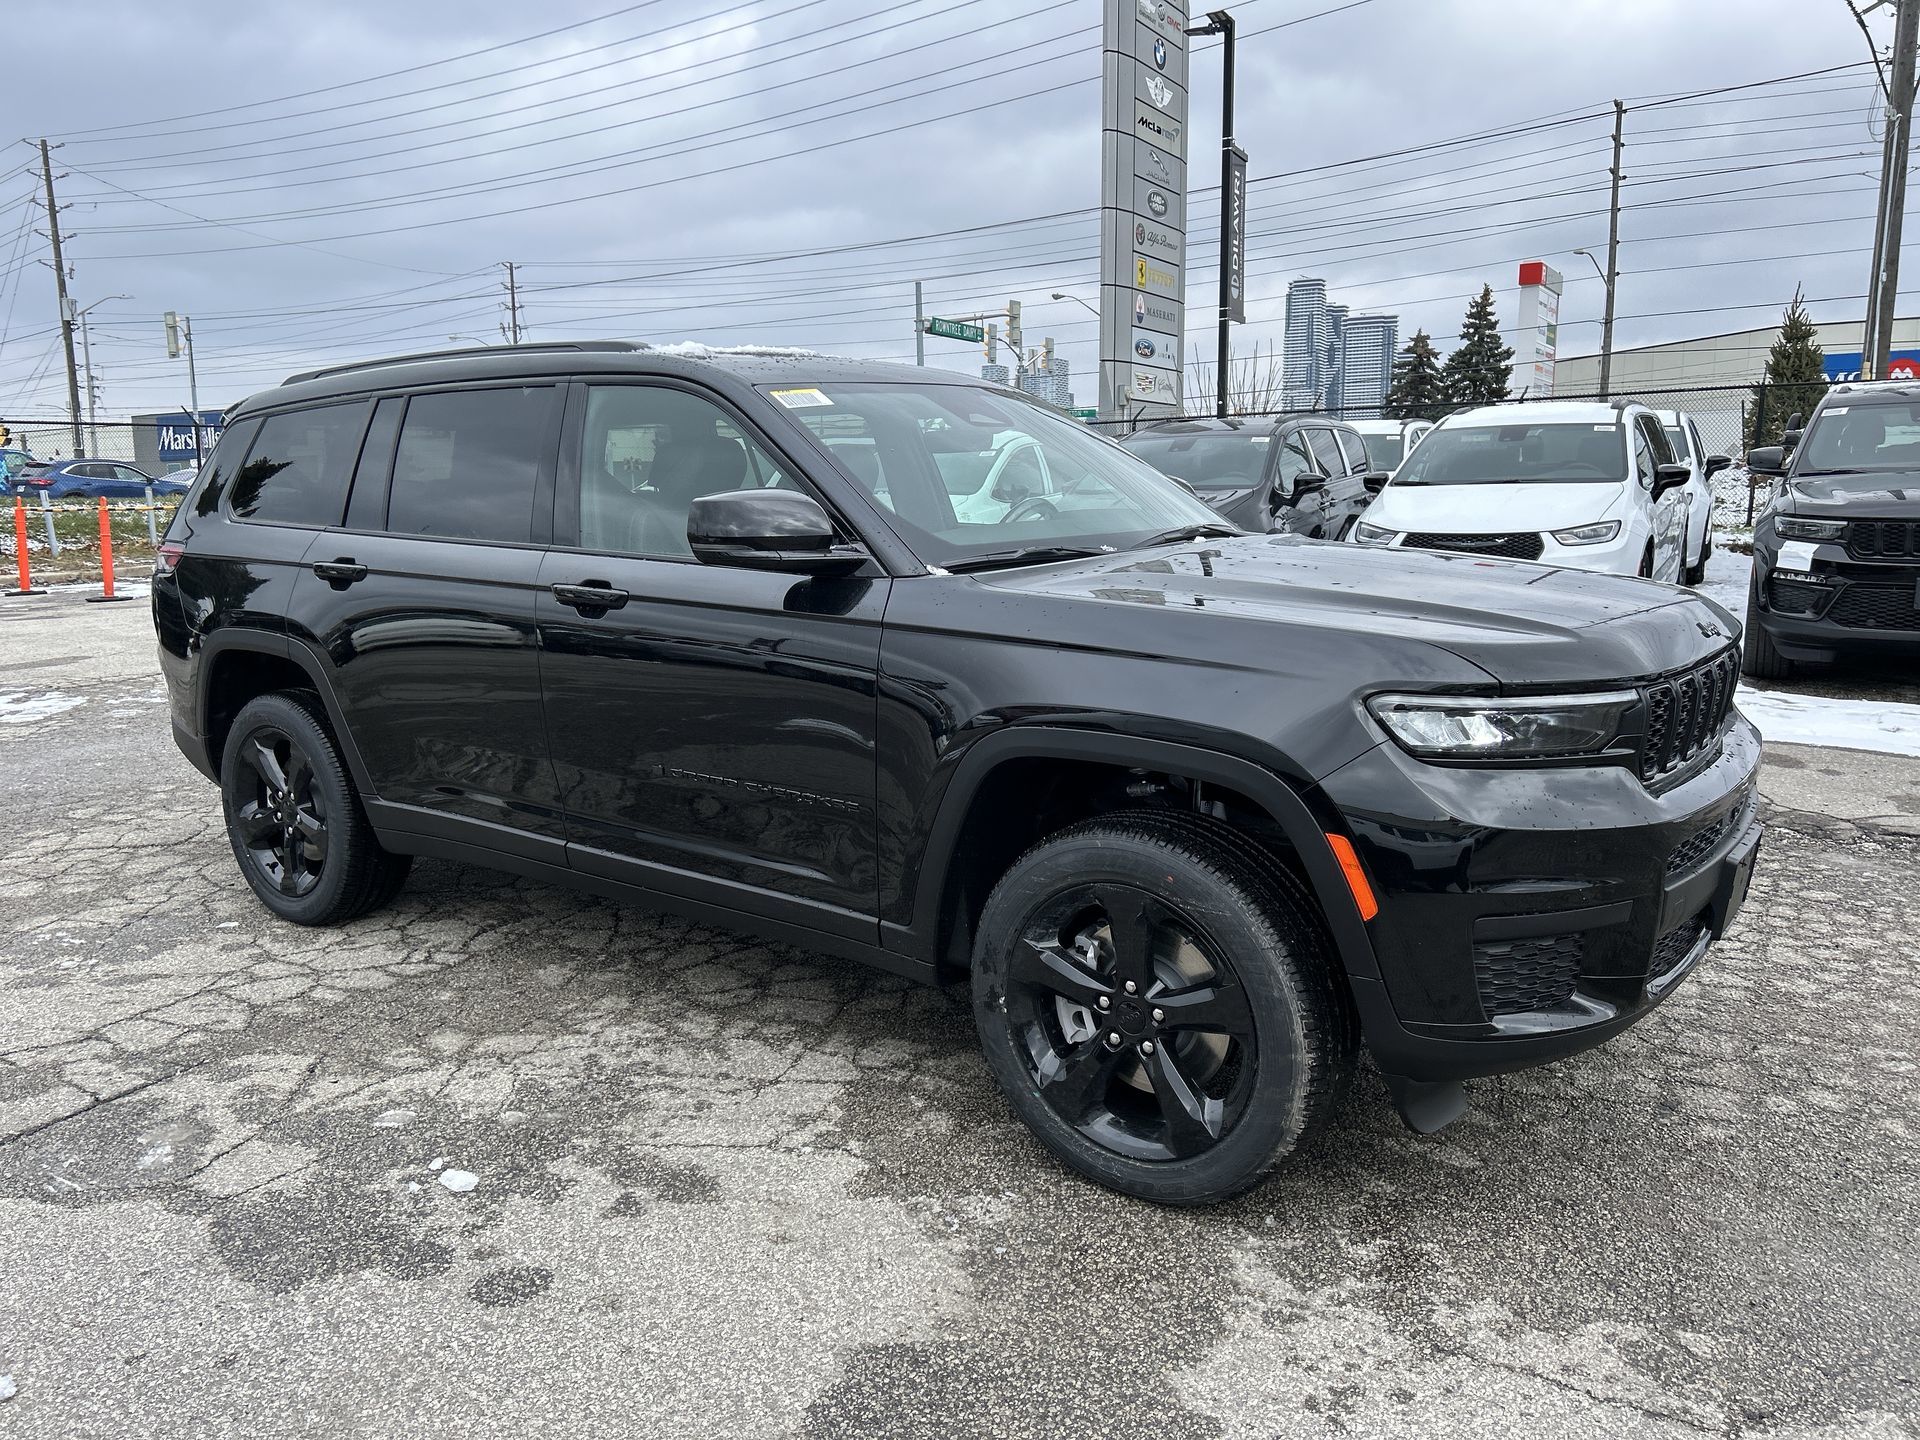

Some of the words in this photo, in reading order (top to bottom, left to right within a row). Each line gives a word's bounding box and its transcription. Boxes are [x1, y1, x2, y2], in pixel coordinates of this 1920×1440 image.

[1167, 16, 1181, 32] GMC
[1137, 116, 1175, 142] McLaren
[1145, 170, 1170, 185] JAGUAR
[1150, 193, 1163, 204] LAND
[1232, 170, 1240, 271] DILAWRI
[1147, 231, 1160, 247] Alfa
[1146, 306, 1176, 323] MASERATI
[936, 320, 961, 336] ROWNTREE
[964, 326, 977, 339] DAIRY
